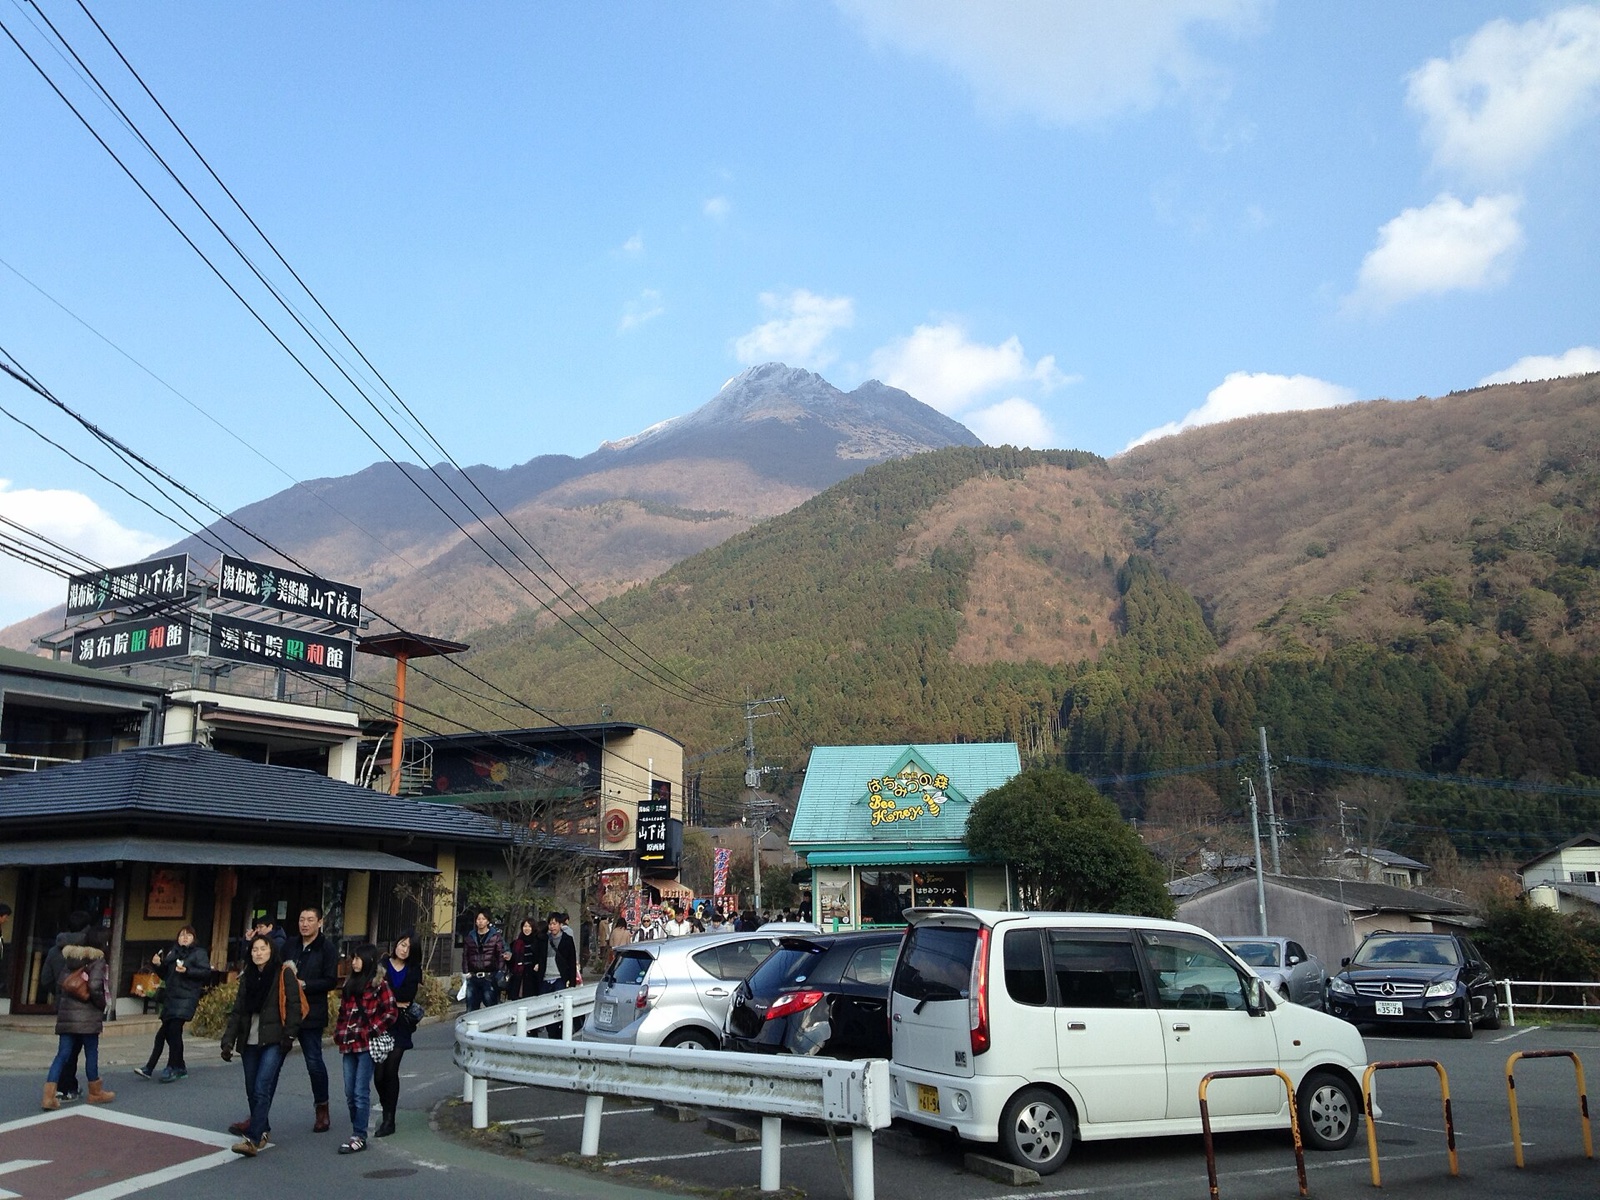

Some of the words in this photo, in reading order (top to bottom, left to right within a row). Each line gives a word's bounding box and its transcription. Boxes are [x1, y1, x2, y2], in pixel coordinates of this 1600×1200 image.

[79, 623, 183, 661] 湯布院昭和館
[219, 626, 344, 669] 湯布院昭和館
[867, 773, 949, 798] はちみつの森
[869, 794, 896, 810] Bee
[871, 805, 924, 827] Honey
[638, 821, 666, 840] 山下清
[1382, 1006, 1402, 1014] 35-78
